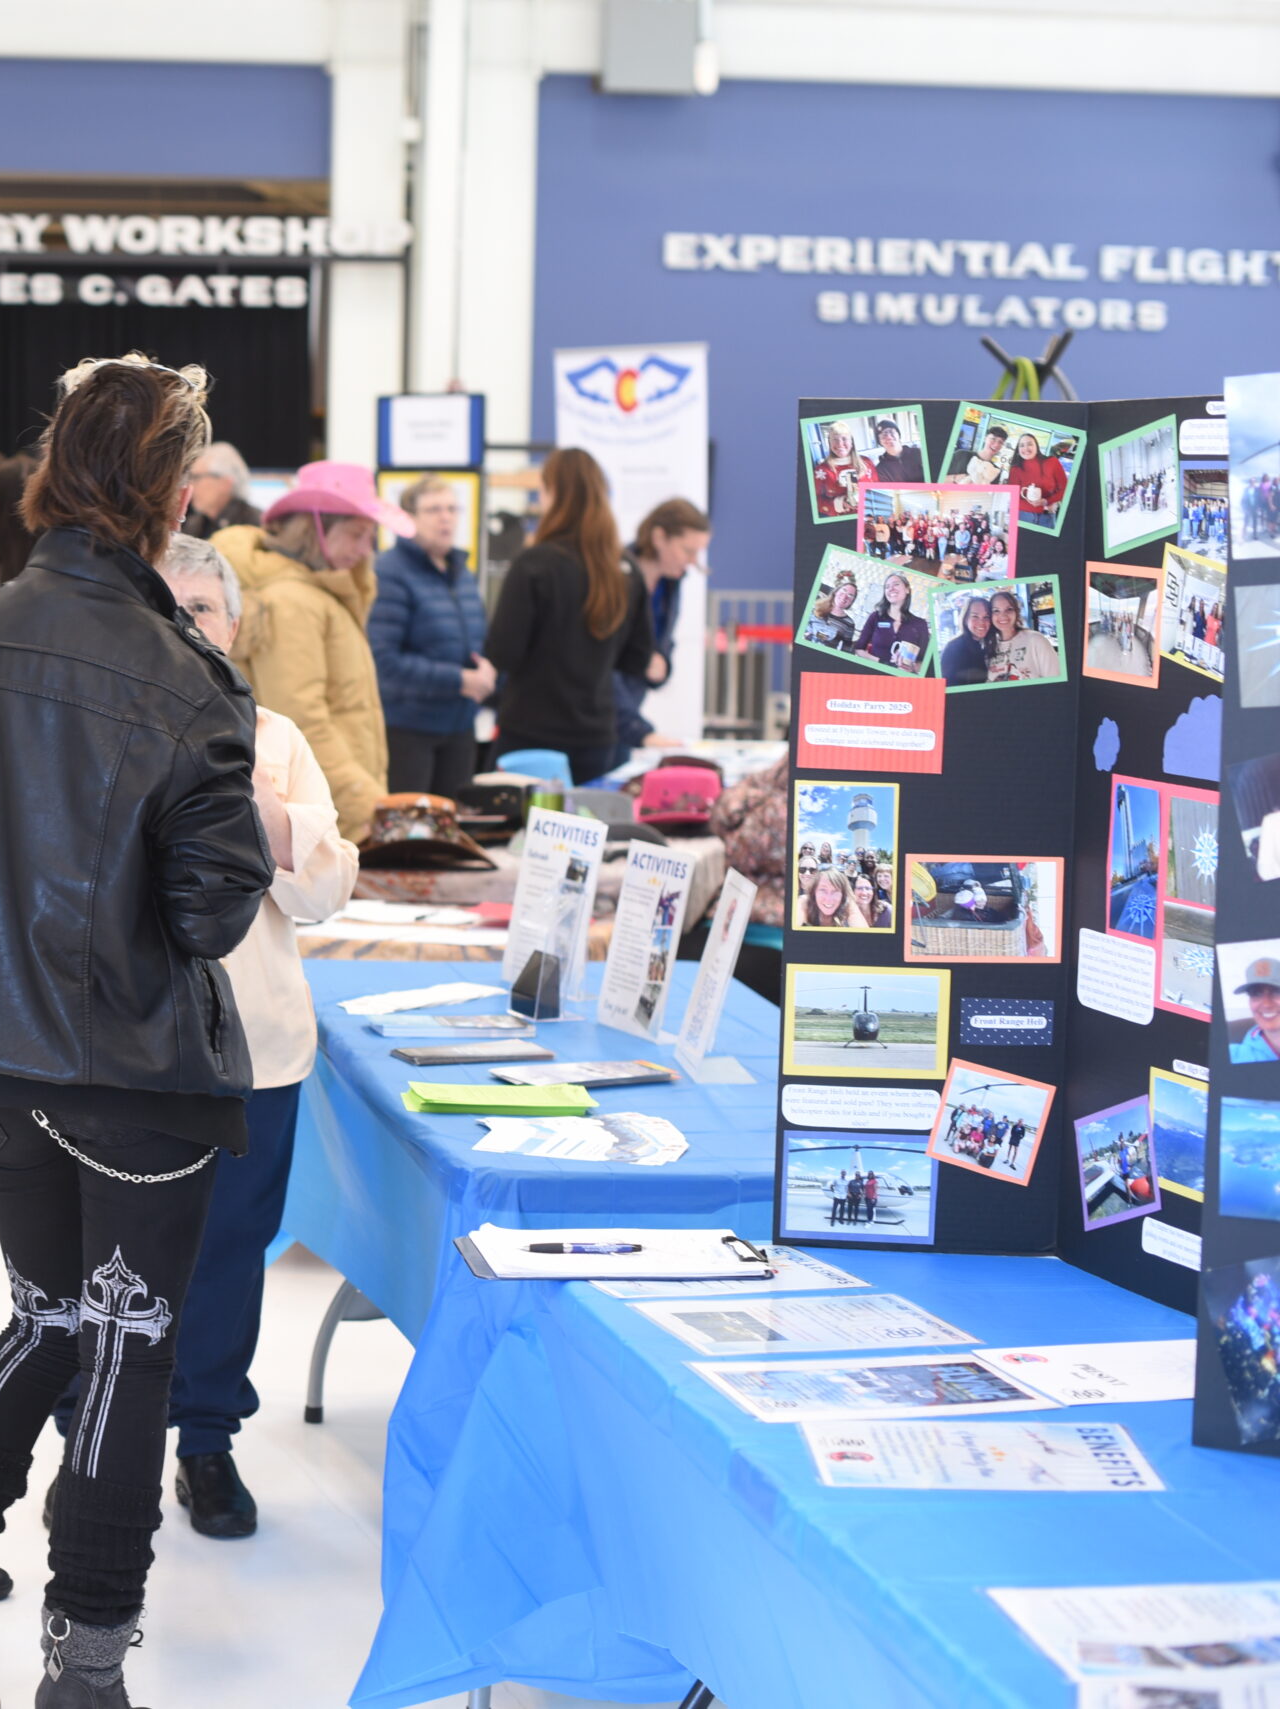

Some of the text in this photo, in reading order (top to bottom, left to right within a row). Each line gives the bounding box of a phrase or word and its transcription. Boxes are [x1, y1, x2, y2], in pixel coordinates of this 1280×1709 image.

[662, 232, 1280, 287] EXPERIENTIAL FLIGH
[78, 273, 127, 305] C.
[135, 274, 309, 308] GATES
[817, 291, 1168, 332] SIMULATORS
[533, 820, 600, 847] ACTIVITIES
[631, 852, 688, 879] ACTIVITIES
[999, 1017, 1025, 1026] Range
[1076, 1428, 1145, 1486] BENEFITS
